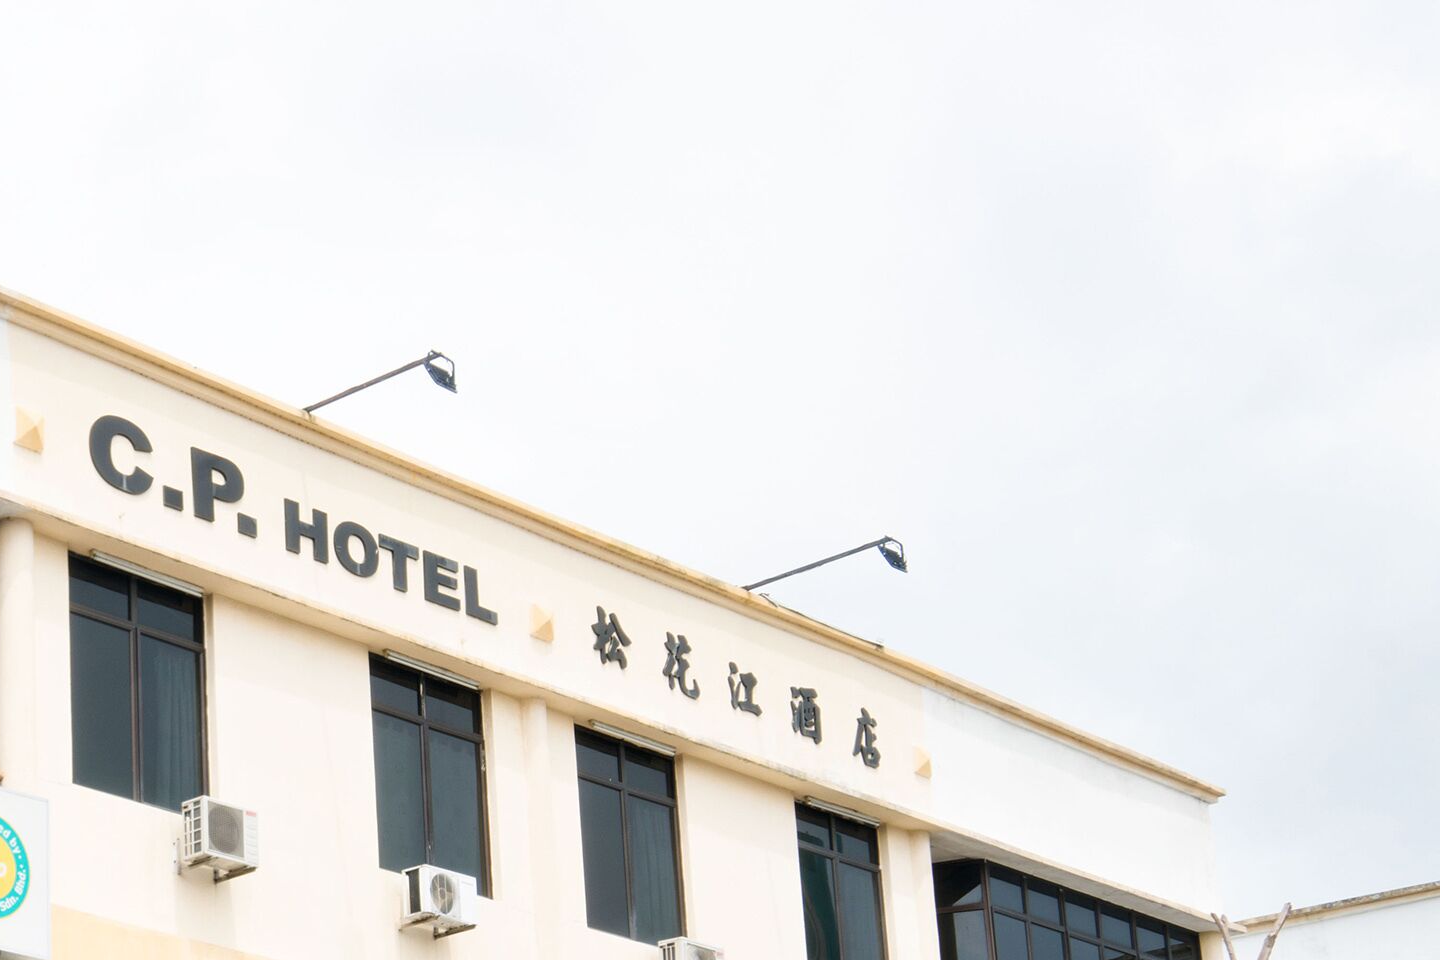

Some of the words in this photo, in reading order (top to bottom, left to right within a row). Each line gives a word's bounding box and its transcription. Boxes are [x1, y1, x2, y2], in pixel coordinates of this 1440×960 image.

[89, 414, 258, 538] C.P.
[283, 497, 499, 626] HOTEL
[591, 605, 881, 769] 松花江酒店
